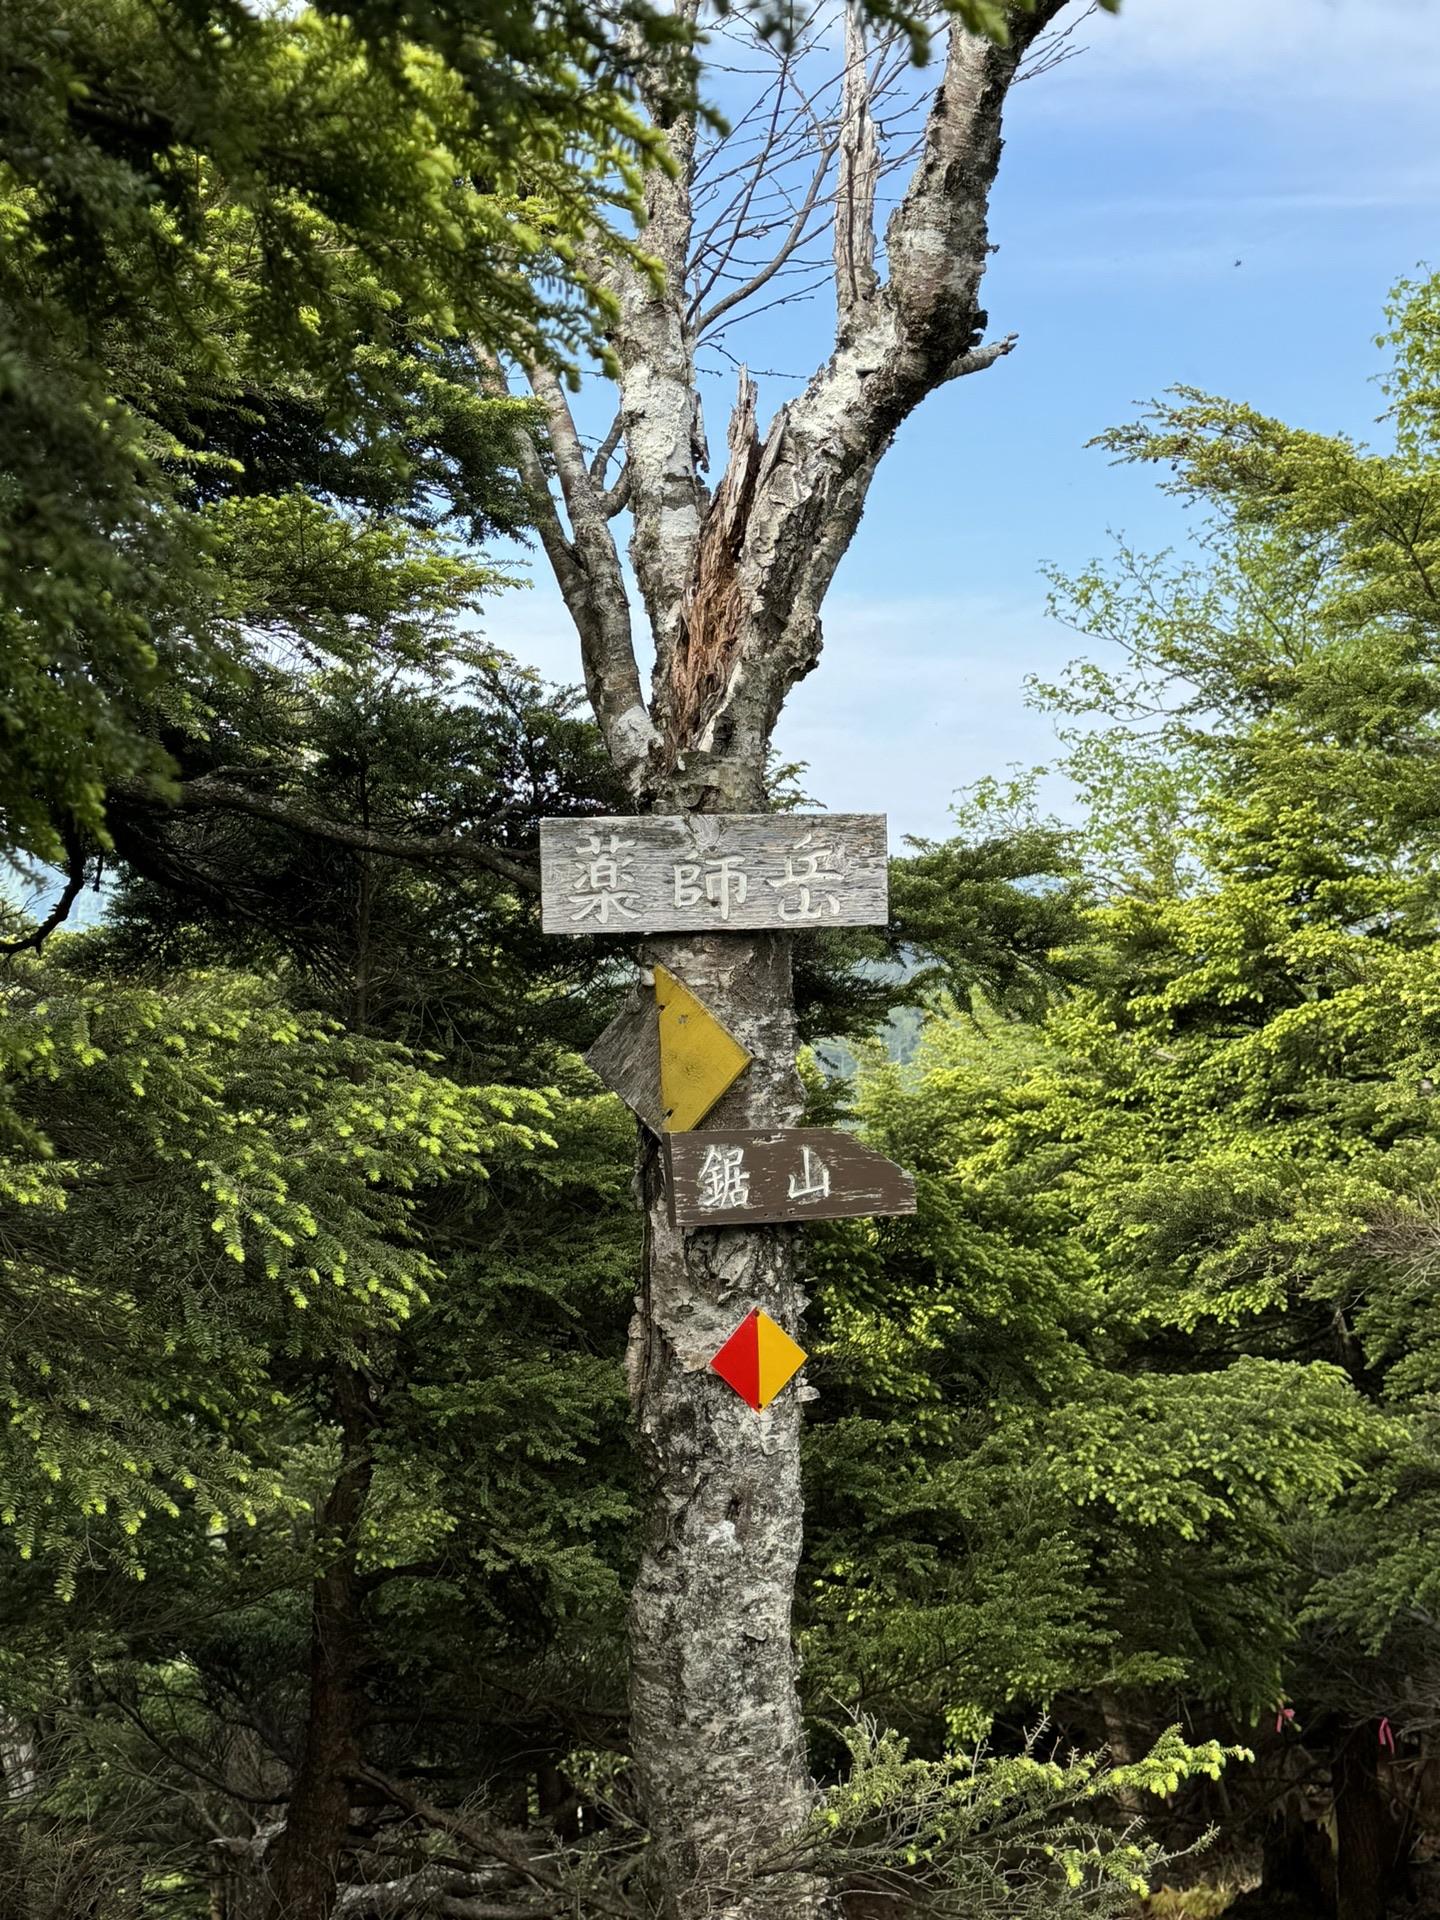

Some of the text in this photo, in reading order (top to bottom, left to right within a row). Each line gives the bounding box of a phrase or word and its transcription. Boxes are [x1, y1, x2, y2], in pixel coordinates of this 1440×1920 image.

[568, 832, 844, 923] 薬師岳
[698, 1145, 831, 1208] 鋸山
